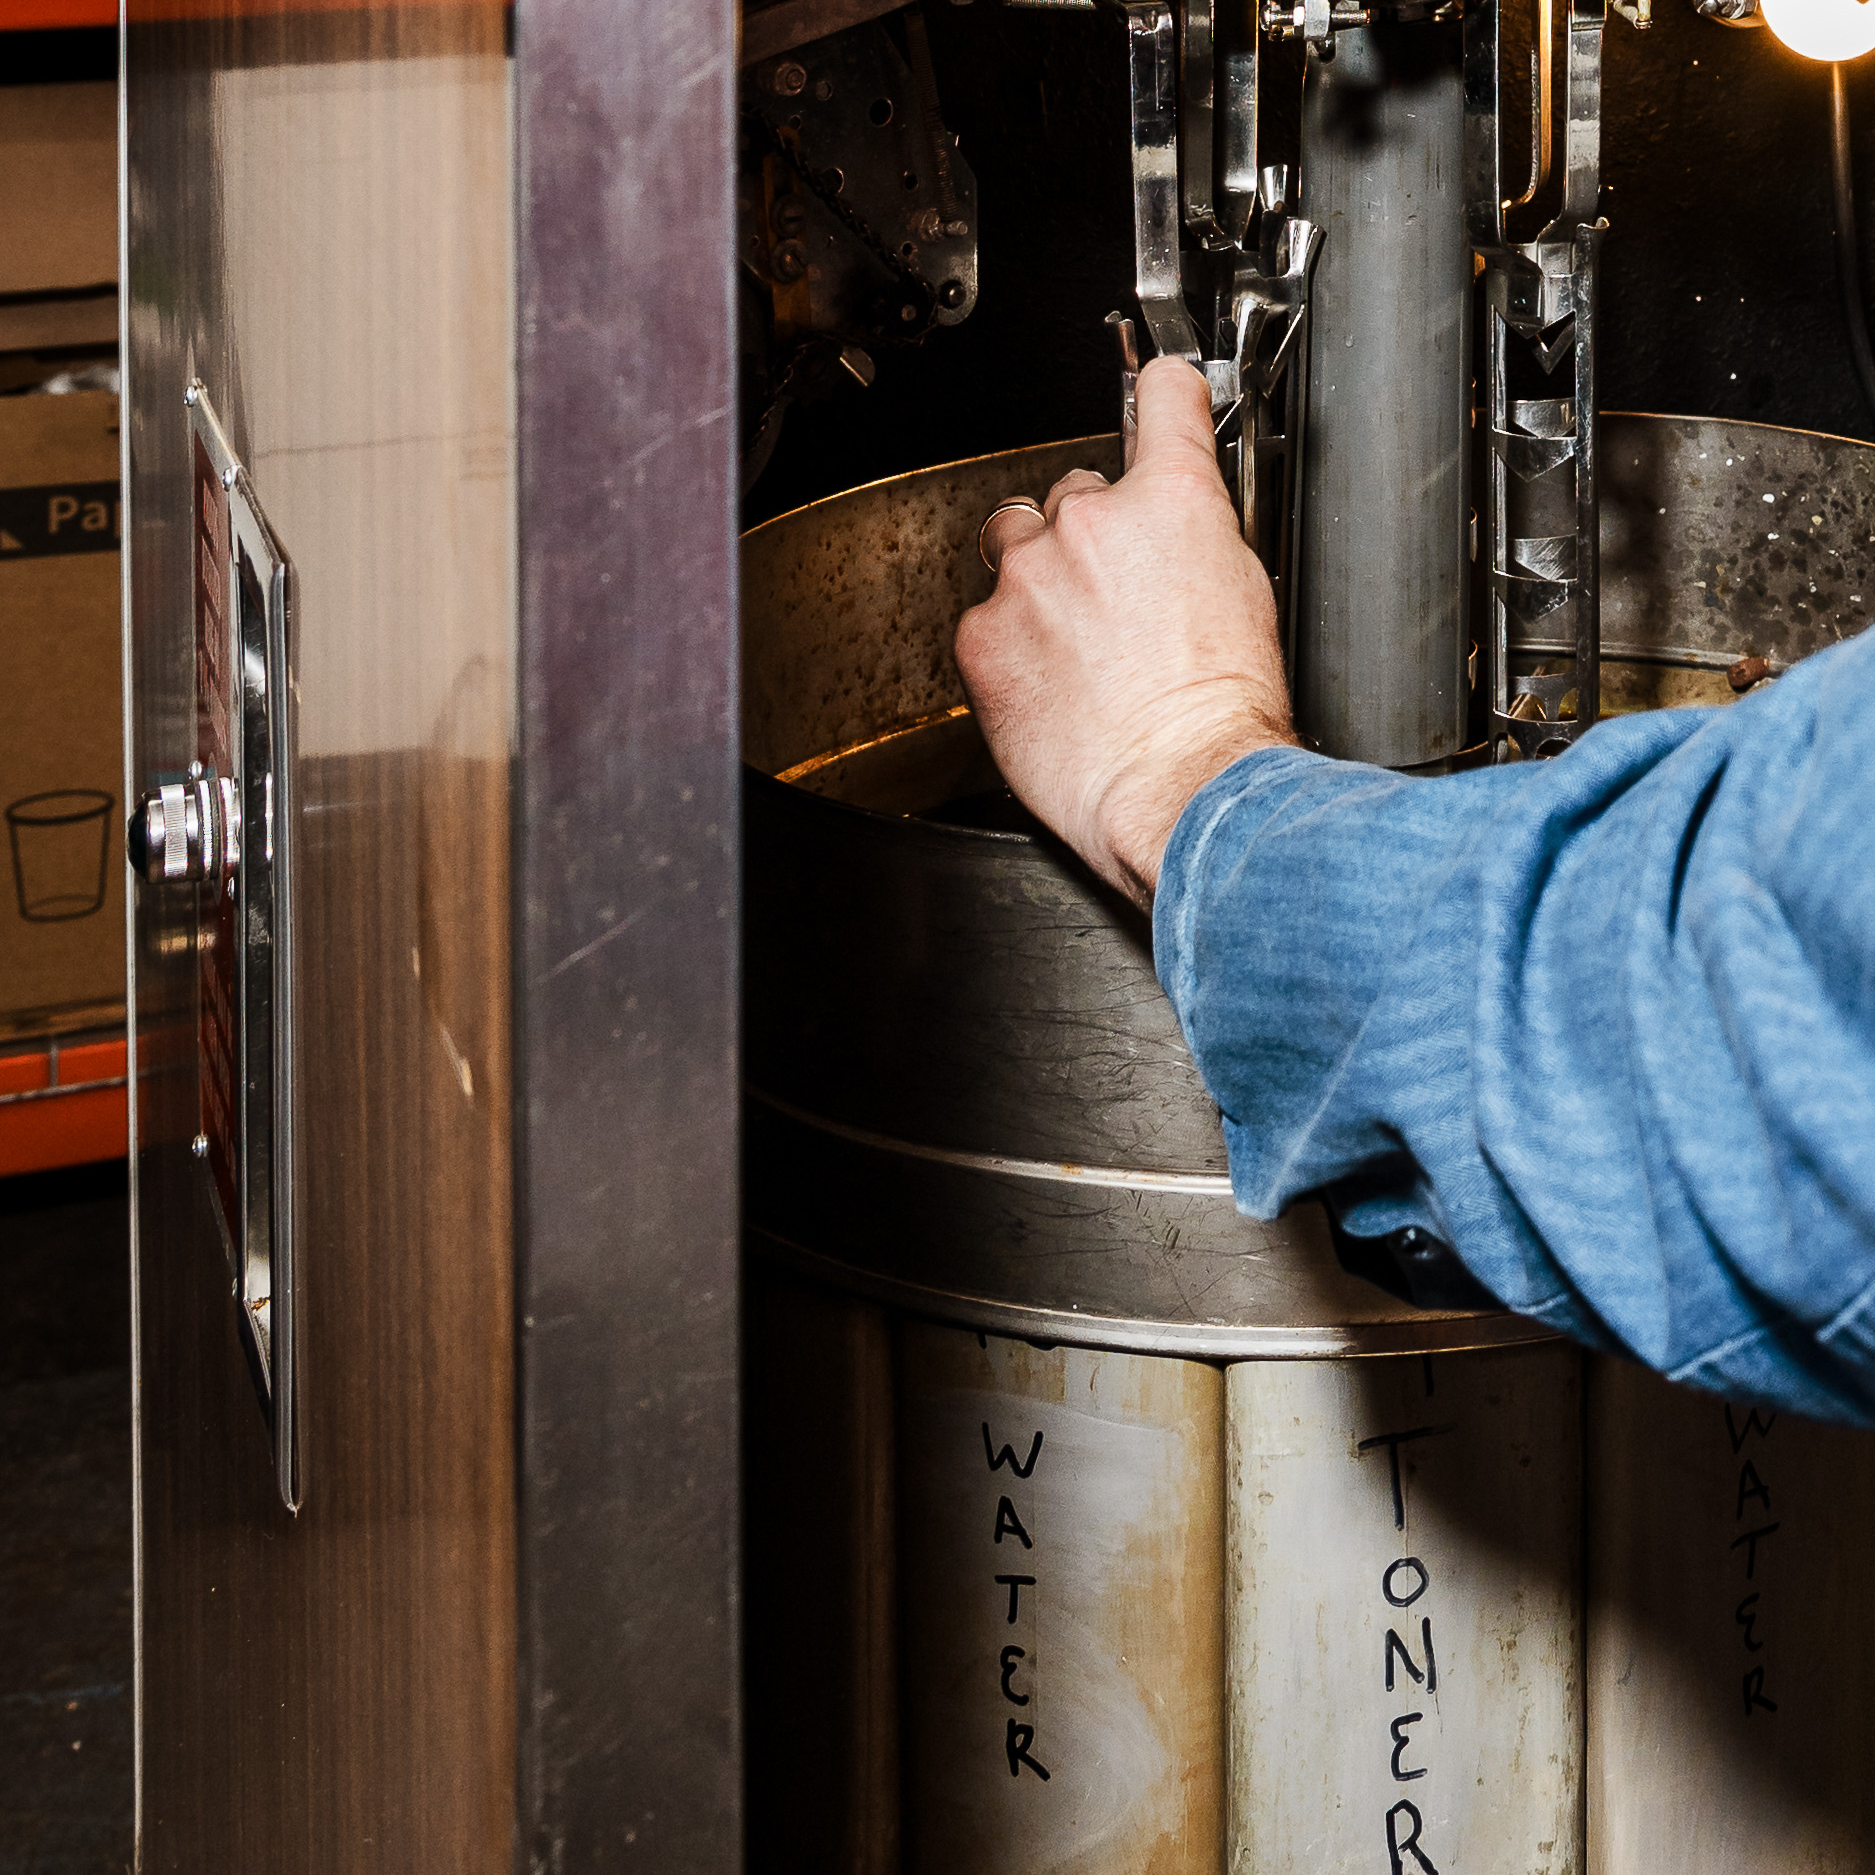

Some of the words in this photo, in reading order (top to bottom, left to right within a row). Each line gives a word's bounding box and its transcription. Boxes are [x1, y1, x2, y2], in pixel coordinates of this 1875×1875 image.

[49, 495, 121, 539] Pa
[980, 1421, 1052, 1782] WATER
[1357, 1426, 1447, 1875] TONER
[1724, 1403, 1780, 1715] WATER
